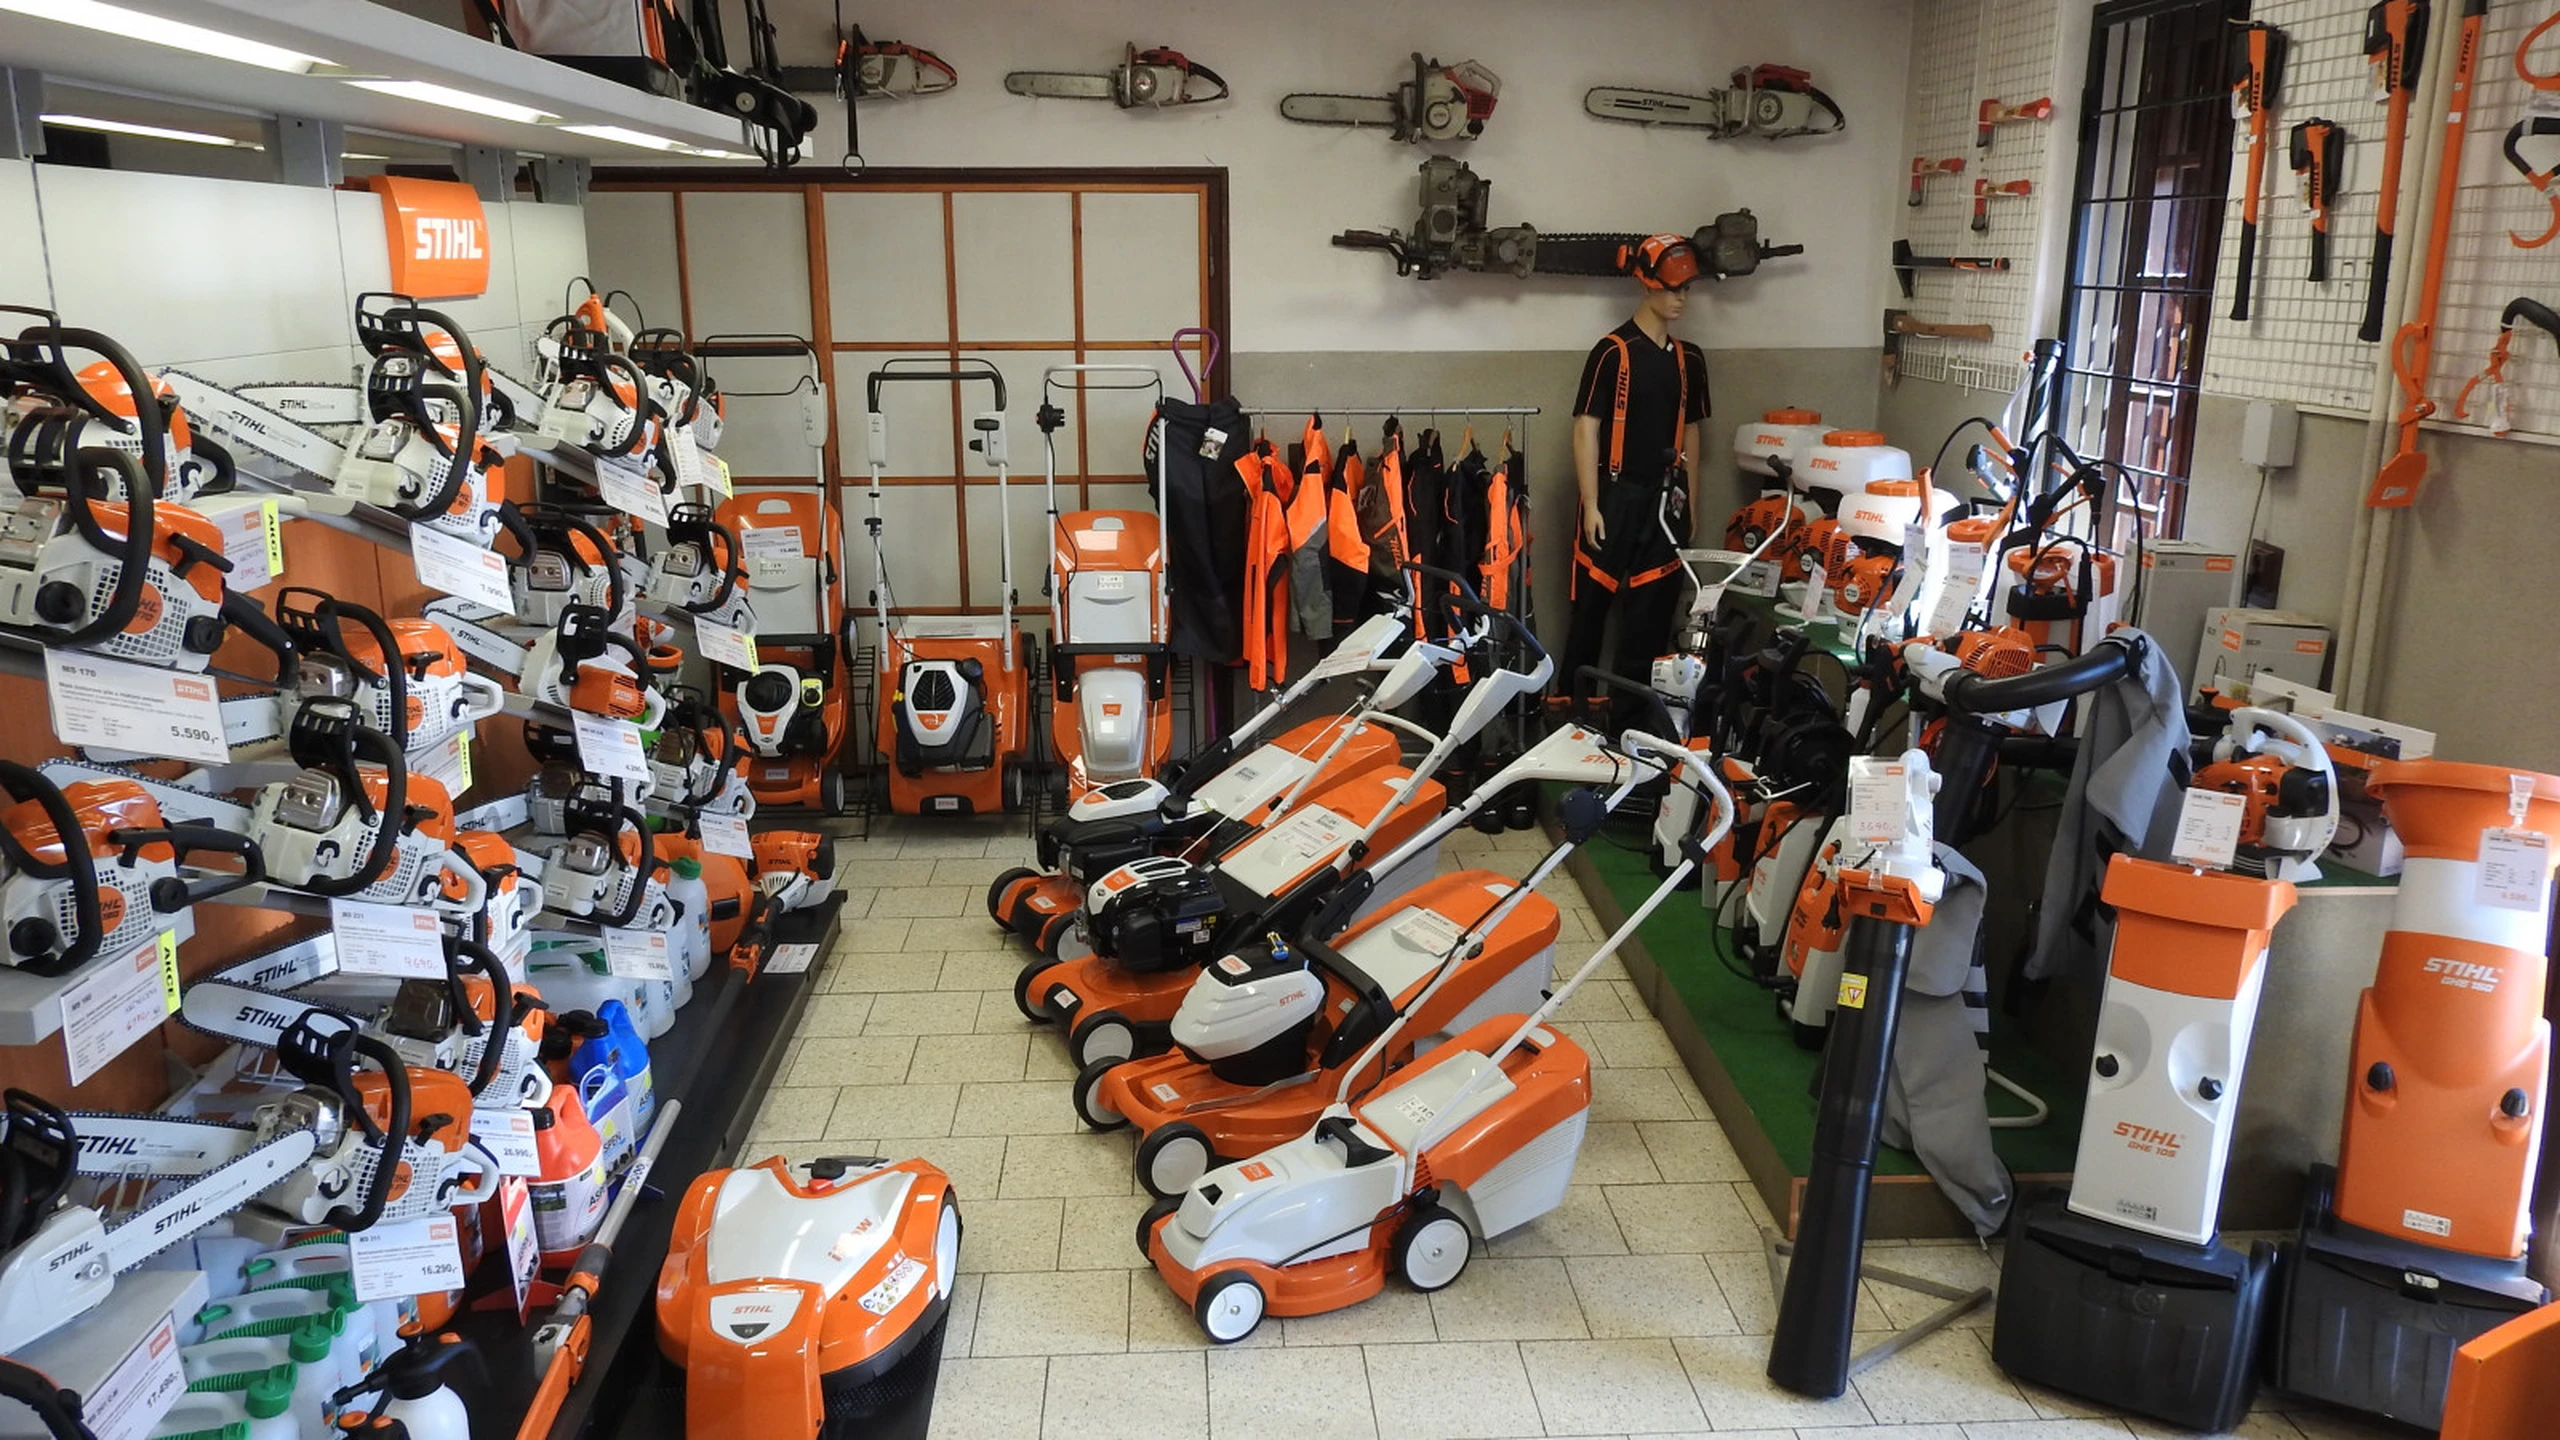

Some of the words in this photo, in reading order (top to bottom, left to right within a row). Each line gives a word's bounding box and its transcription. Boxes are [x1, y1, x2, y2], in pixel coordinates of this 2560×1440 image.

[2459, 29, 2472, 74] STIHL
[415, 217, 483, 260] STIHL
[1617, 367, 1628, 410] STIHL
[279, 399, 307, 409] STIHL
[1755, 435, 1785, 446] STIHL
[1809, 458, 1838, 471] STIHL
[1854, 509, 1885, 523] STIHL
[457, 630, 482, 645] STIHL
[176, 684, 208, 697] STIHL
[171, 725, 220, 744] 5.590,-
[254, 958, 298, 987] STIHL
[2423, 956, 2498, 984] STIHL
[1279, 990, 1306, 1006] STIHL
[236, 1006, 287, 1031] STIHL
[2114, 1120, 2180, 1148] STIHL
[75, 1134, 138, 1155] STIHL
[2128, 1141, 2151, 1153] GHE
[2156, 1147, 2177, 1158] 105
[154, 1199, 202, 1234] STIHL
[48, 1240, 94, 1272] STIHL
[732, 1304, 773, 1315] STIHL
